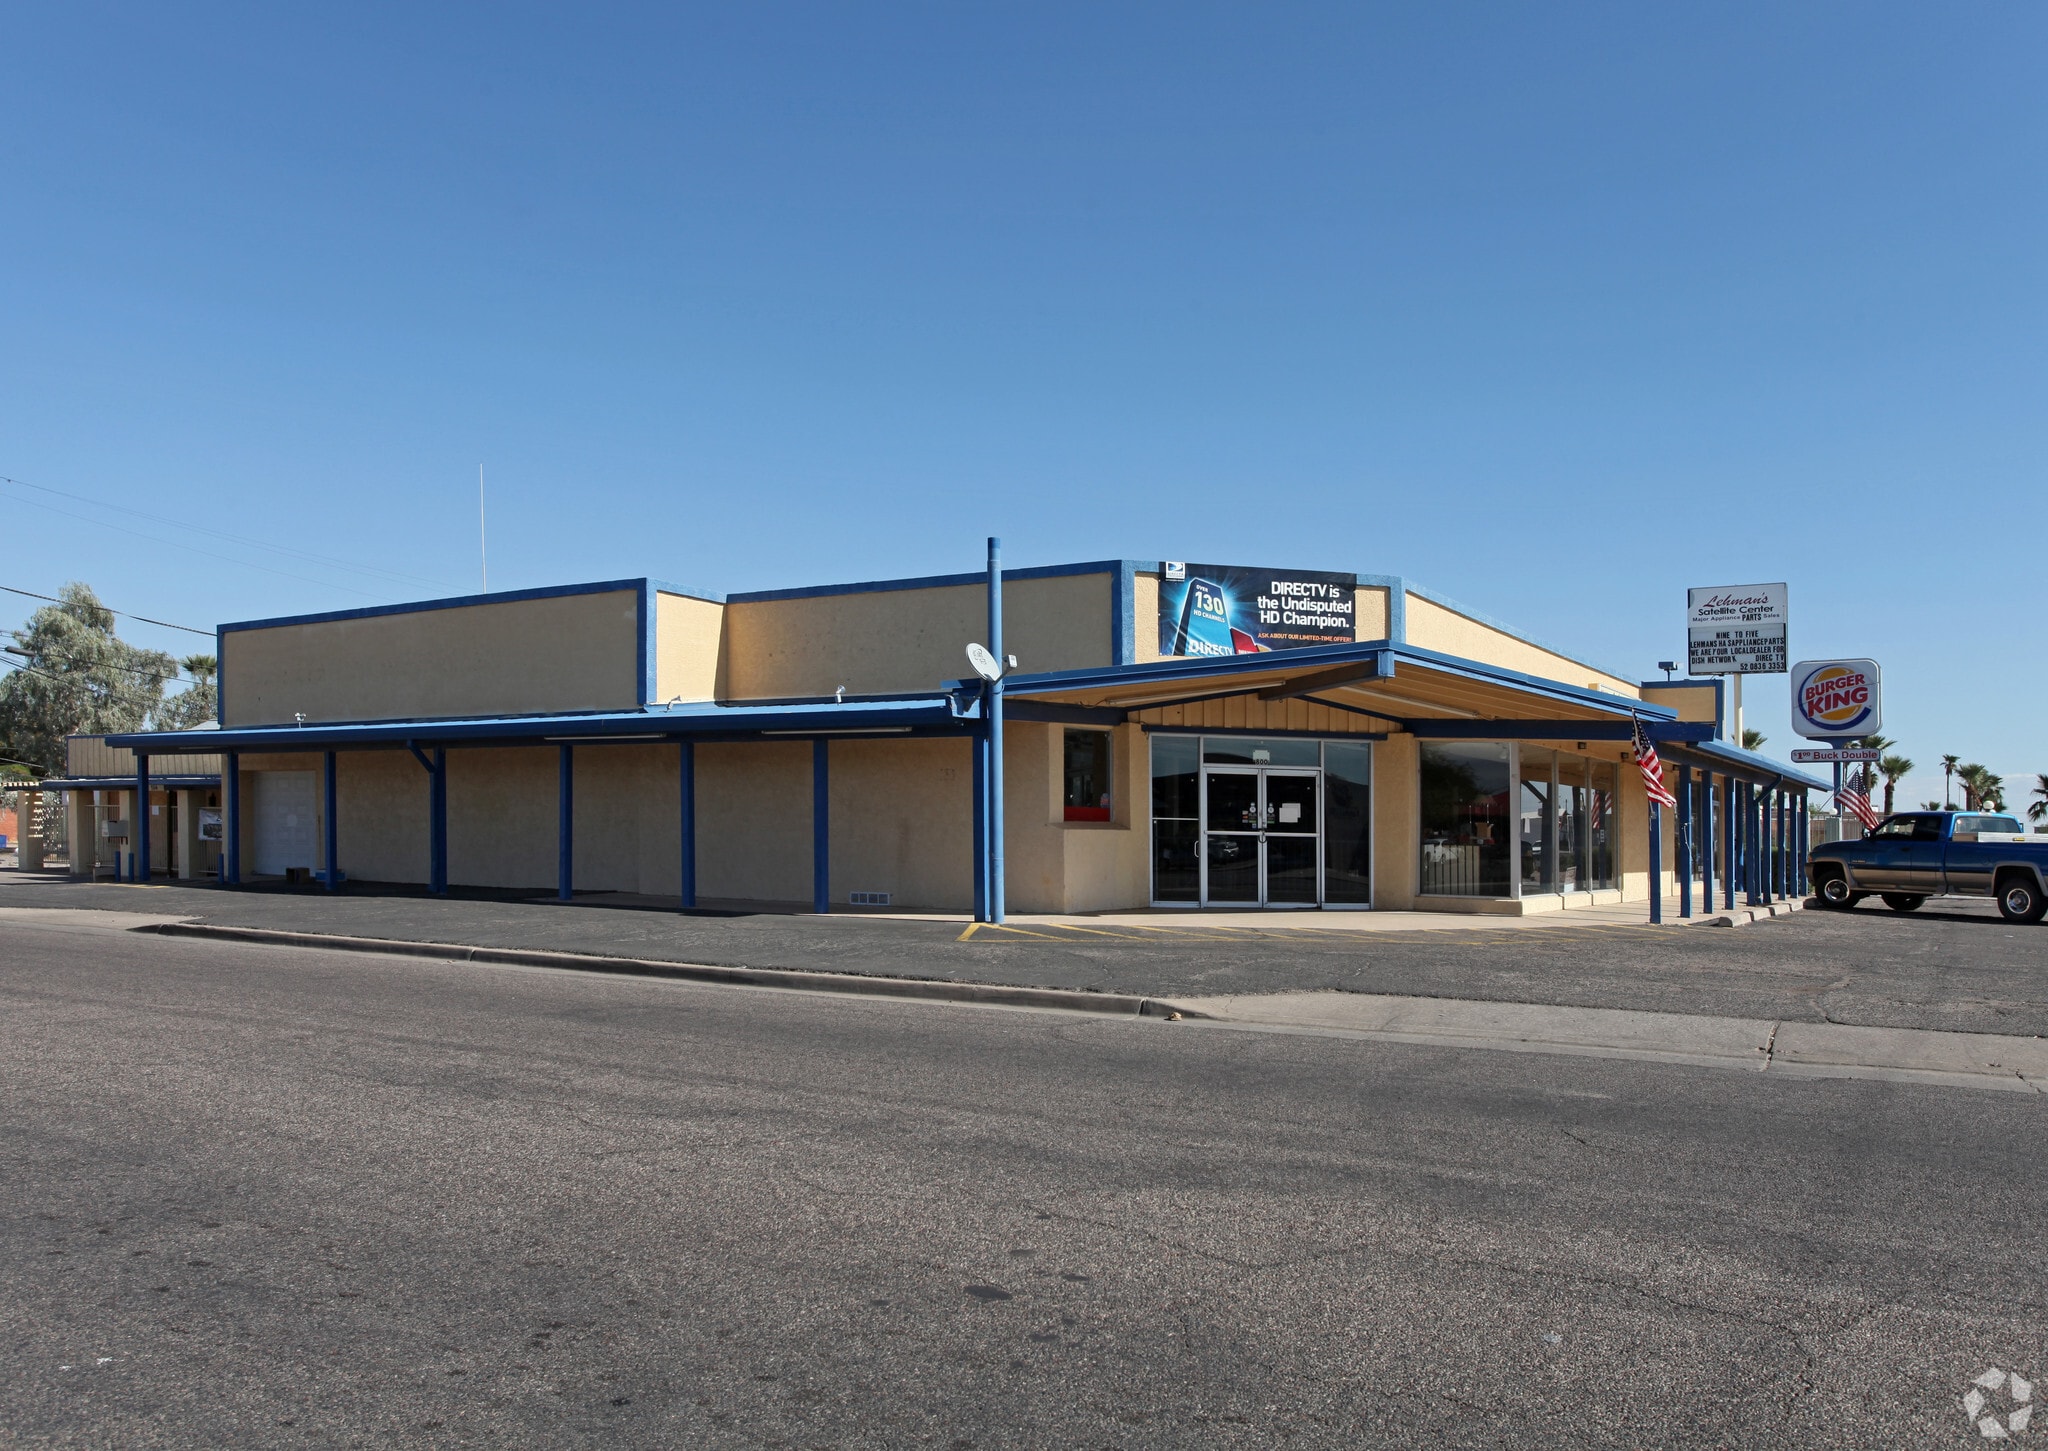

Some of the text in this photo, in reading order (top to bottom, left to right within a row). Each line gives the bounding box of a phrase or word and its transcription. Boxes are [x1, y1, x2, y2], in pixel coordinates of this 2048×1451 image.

[1272, 582, 1340, 598] DIRECTV is
[1195, 592, 1224, 616] 130
[1257, 596, 1351, 614] the Undisputed
[1703, 592, 1768, 607] Lehman's
[1260, 610, 1349, 629] HD Champion.
[1698, 606, 1774, 616] Satellite Center
[1188, 639, 1233, 655] DIRECTV
[1805, 674, 1866, 700] BURGER
[1807, 687, 1868, 718] KING
[1813, 752, 1839, 760] Buck
[1842, 750, 1878, 759] Double
